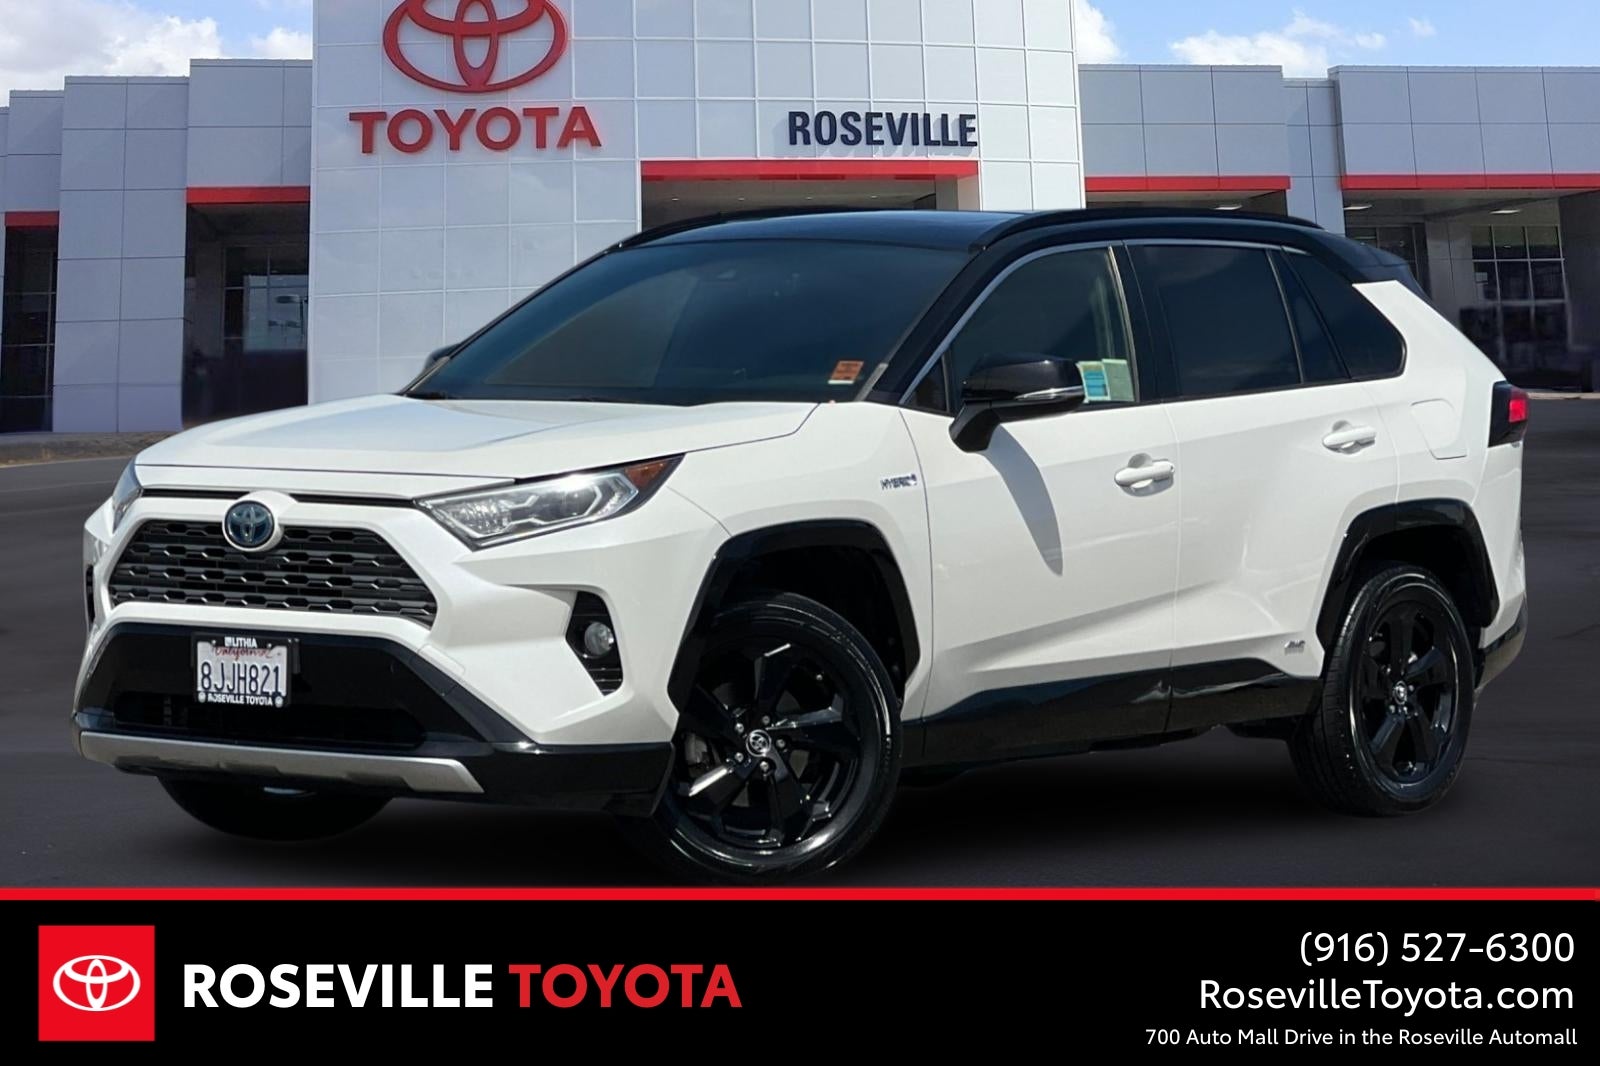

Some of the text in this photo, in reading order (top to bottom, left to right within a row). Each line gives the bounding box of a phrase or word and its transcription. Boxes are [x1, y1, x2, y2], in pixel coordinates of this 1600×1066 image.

[349, 106, 602, 154] TOYOTA
[788, 110, 978, 147] ROSEVILLE
[232, 637, 257, 648] LITHIA
[201, 661, 279, 695] 8JJH821
[245, 695, 273, 706] TOYOTA
